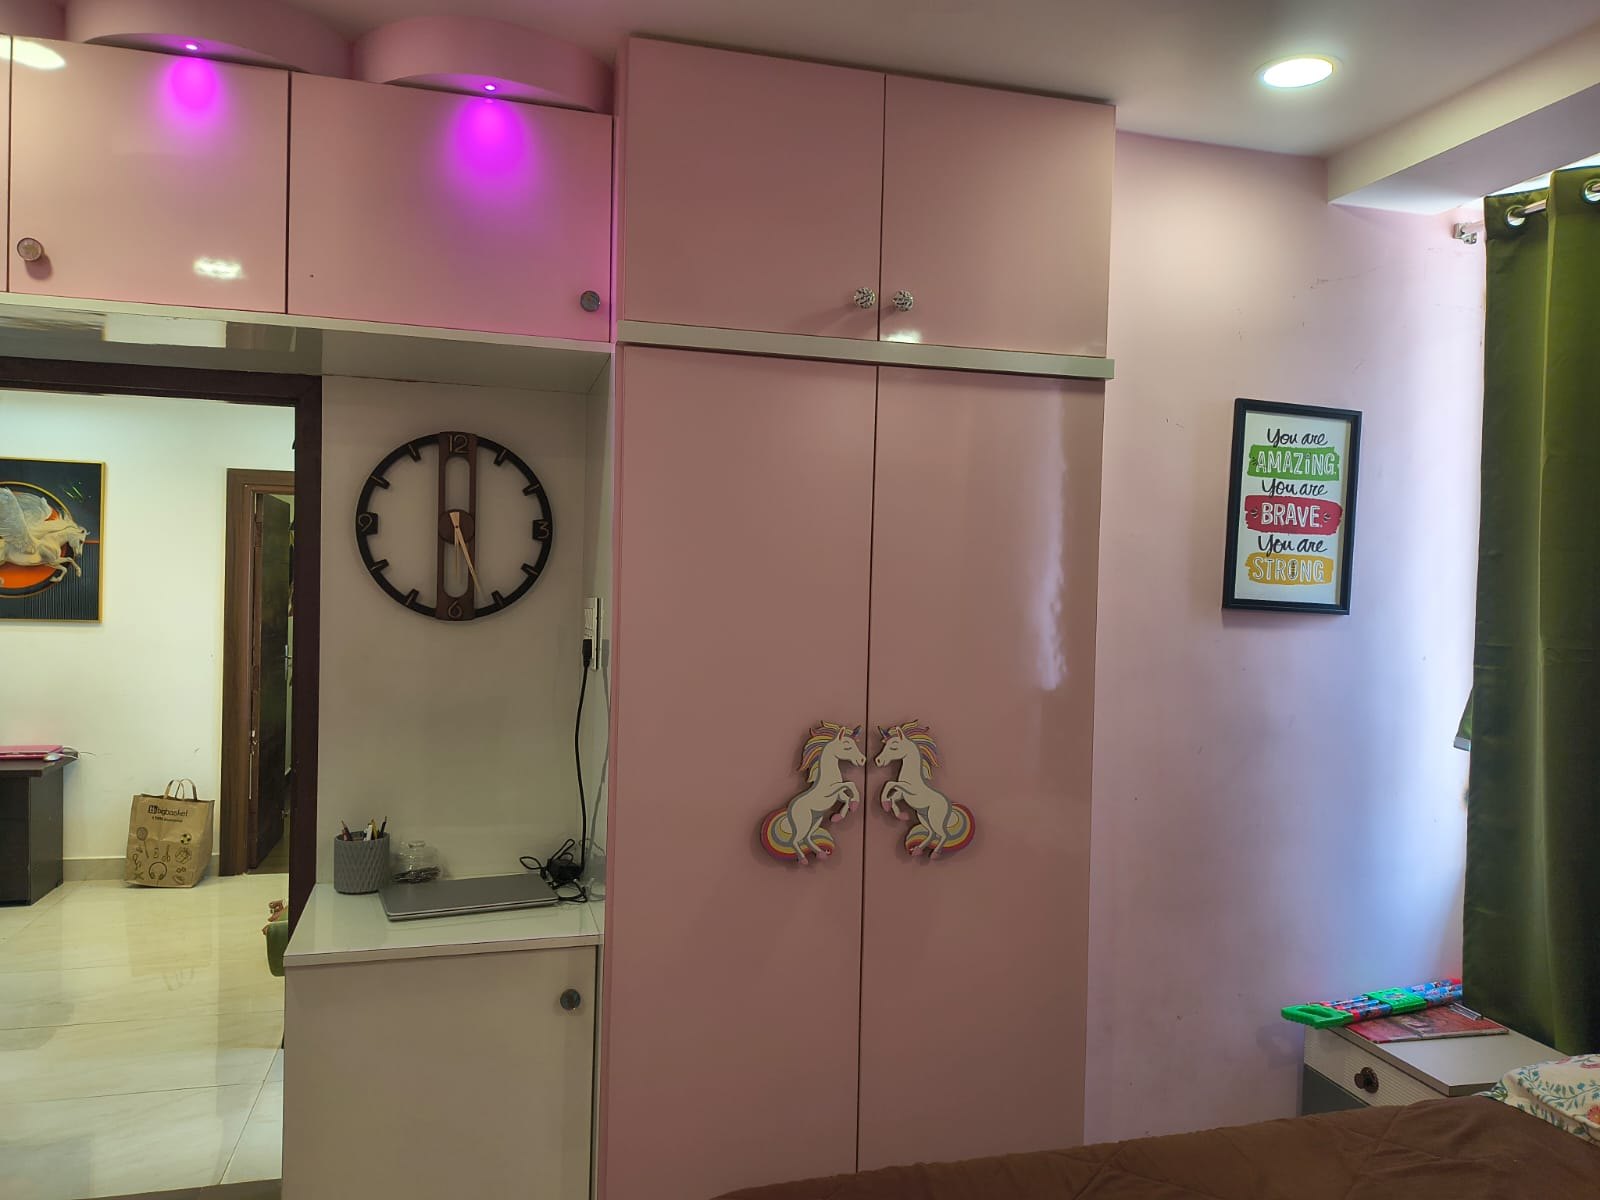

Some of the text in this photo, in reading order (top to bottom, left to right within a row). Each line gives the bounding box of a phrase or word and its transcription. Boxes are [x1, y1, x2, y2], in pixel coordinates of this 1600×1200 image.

[449, 434, 468, 454] 12
[1267, 428, 1328, 447] You are
[1262, 478, 1328, 497] You are
[358, 514, 373, 532] 9
[537, 521, 550, 539] 3
[1258, 534, 1328, 557] You are
[1252, 556, 1325, 582] STRONG
[448, 601, 462, 618] 6
